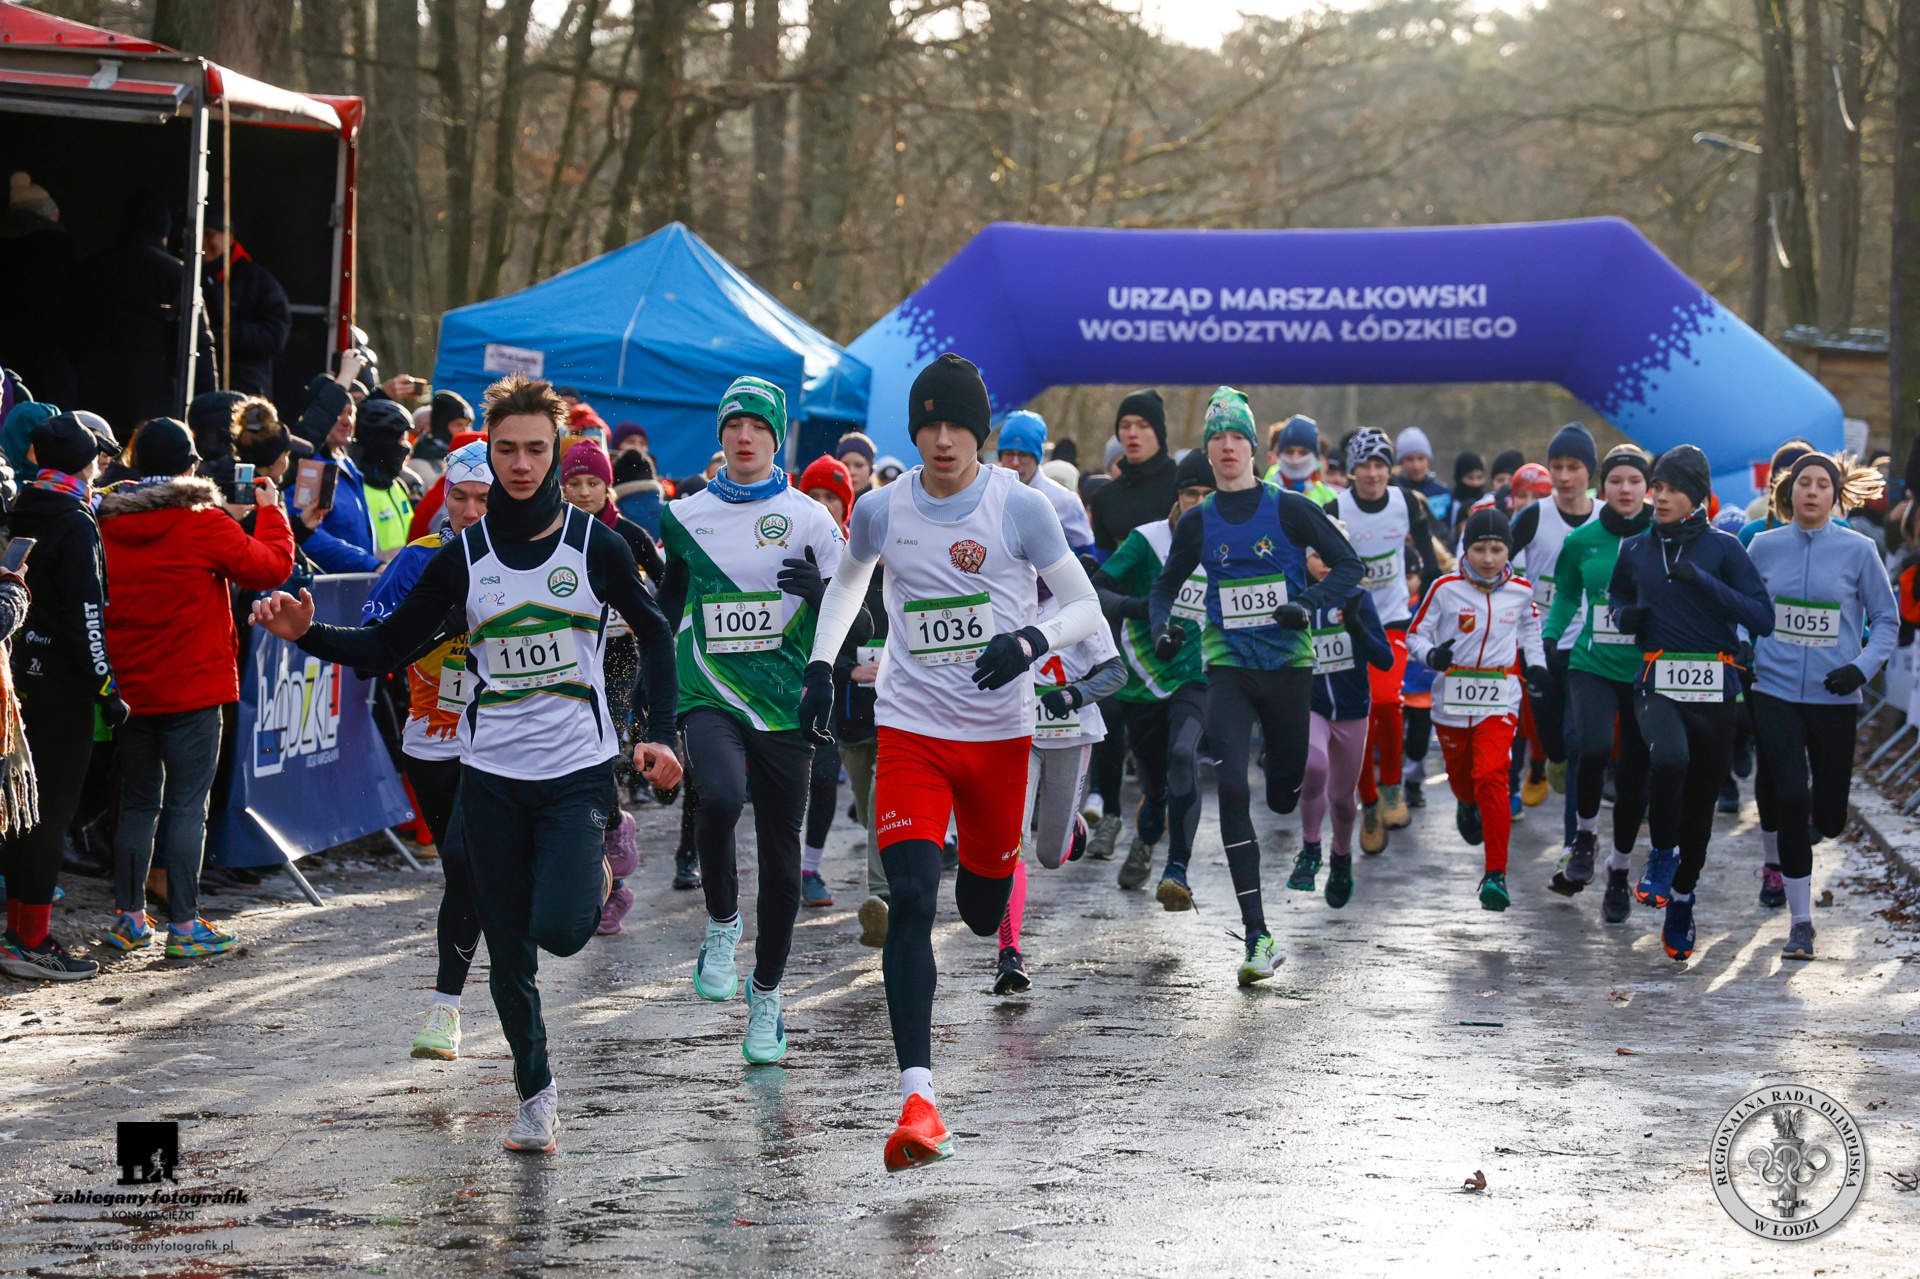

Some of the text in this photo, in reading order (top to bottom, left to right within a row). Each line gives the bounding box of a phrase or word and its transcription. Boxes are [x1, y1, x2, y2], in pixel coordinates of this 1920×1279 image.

[1107, 284, 1487, 316] URZĄD MARSZAŁKOWSKI
[1079, 314, 1517, 343] WOJEWÓDZTWA ŁÓDZKIEGO
[764, 517, 784, 528] RKS
[480, 575, 501, 584] esa
[551, 571, 573, 585] RKS
[1365, 563, 1392, 579] 032
[1181, 587, 1207, 605] 07
[1231, 591, 1278, 611] 1038
[714, 610, 772, 632] 1002
[919, 616, 983, 644] 1036
[1784, 613, 1830, 632] 1055
[500, 641, 561, 669] 1101
[1667, 668, 1714, 686] 1028
[1456, 685, 1500, 701] 1072
[881, 810, 897, 822] LKS
